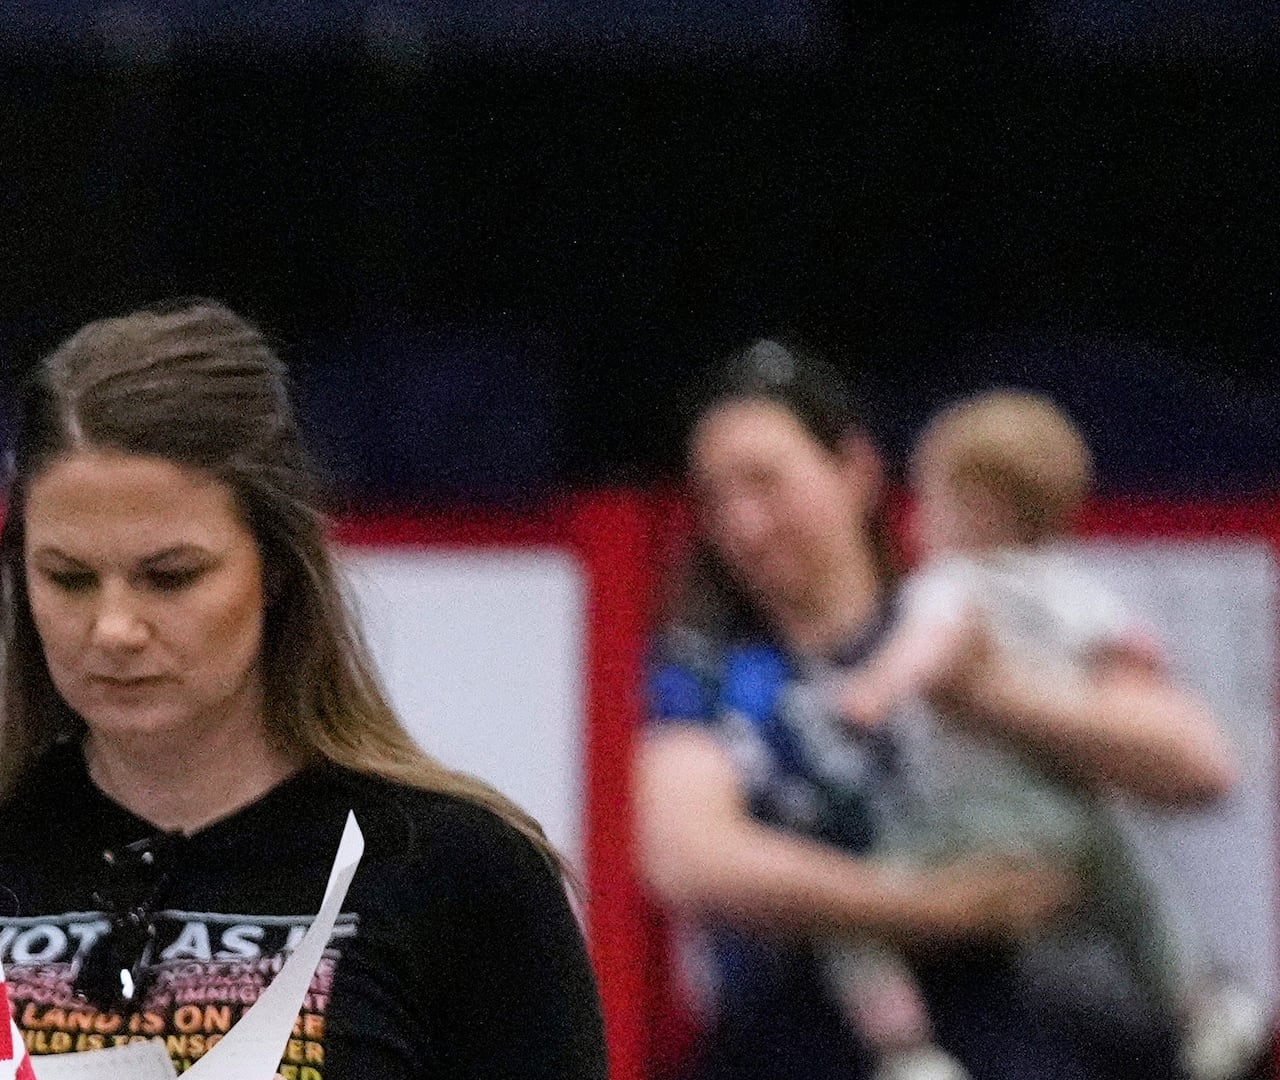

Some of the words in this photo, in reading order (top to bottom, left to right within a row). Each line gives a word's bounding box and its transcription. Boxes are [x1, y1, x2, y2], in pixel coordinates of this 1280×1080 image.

[160, 921, 265, 961] AS
[129, 1008, 166, 1034] IS
[174, 1004, 232, 1034] ON
